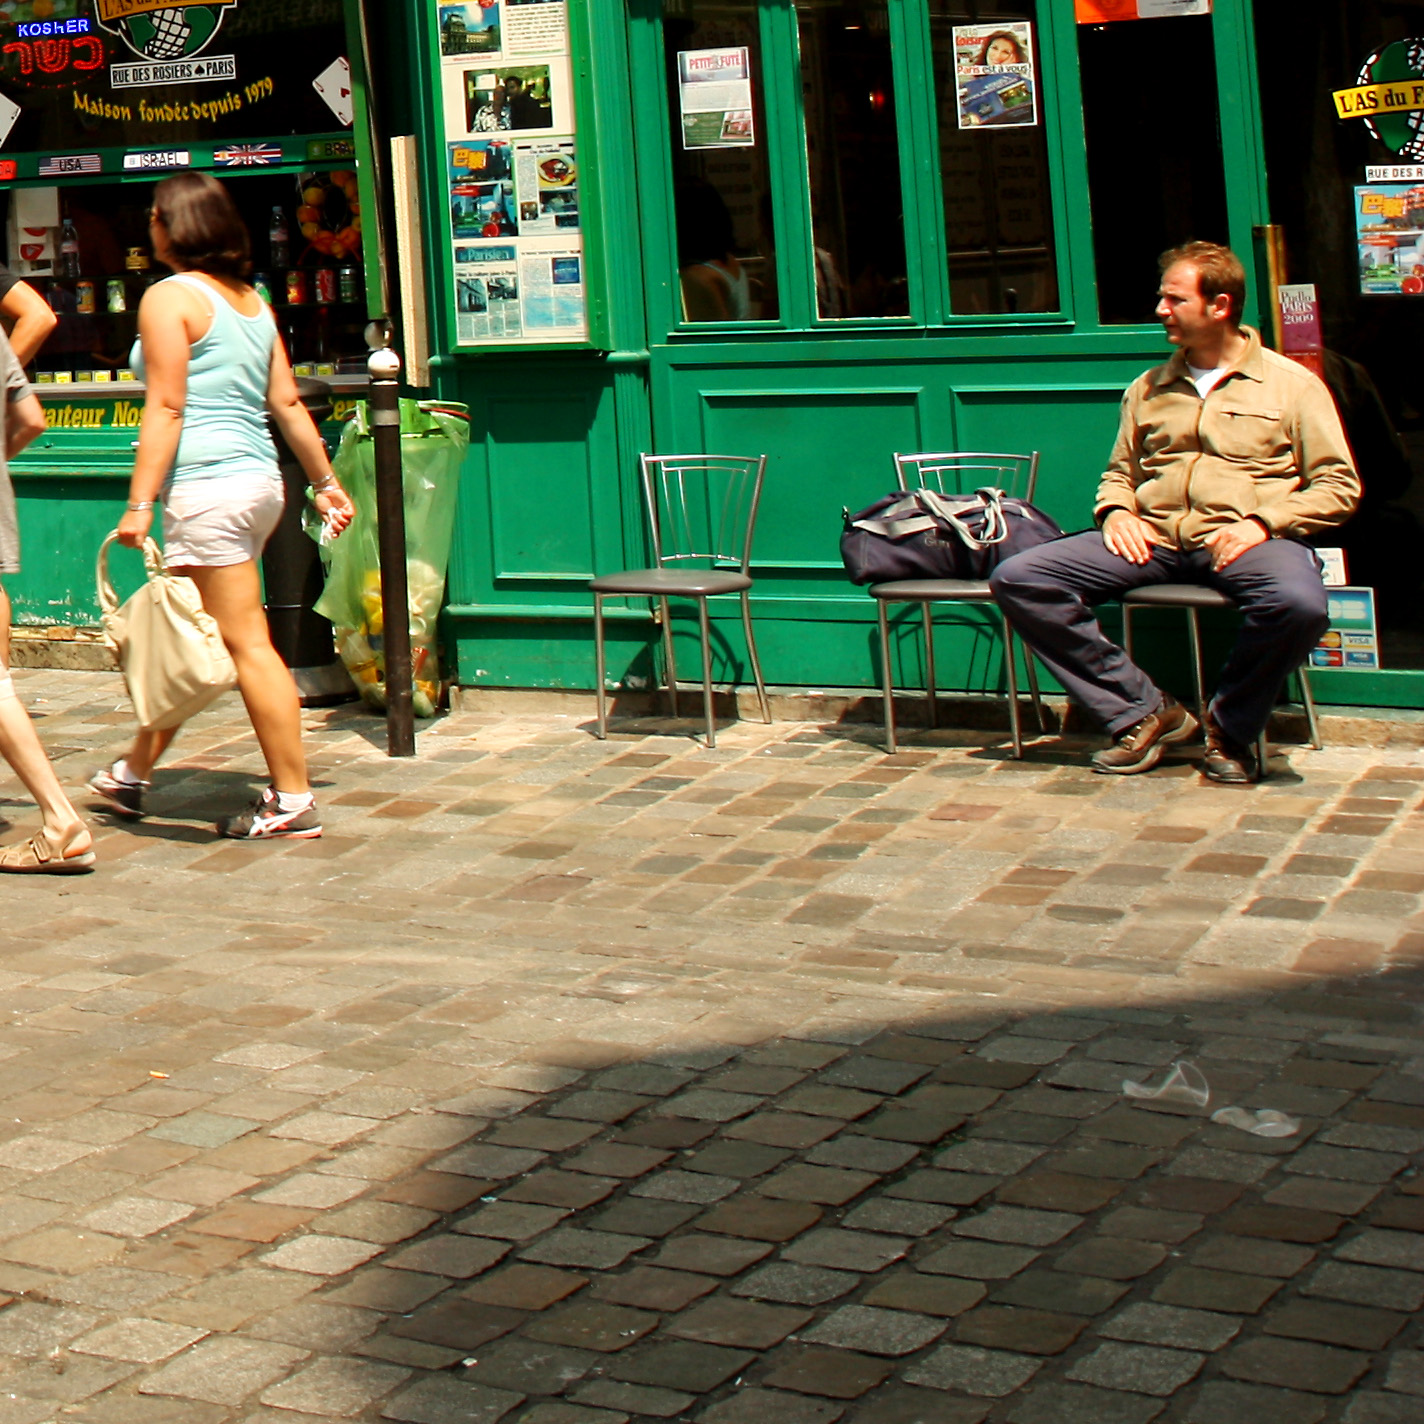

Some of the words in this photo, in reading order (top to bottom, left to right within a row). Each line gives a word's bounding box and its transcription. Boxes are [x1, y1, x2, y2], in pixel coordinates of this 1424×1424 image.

[2, 35, 105, 74] כשר
[113, 70, 130, 83] RUE
[133, 68, 151, 81] DES
[153, 64, 192, 79] ROSIERS
[206, 60, 234, 75] PARIS
[74, 90, 132, 121] Maison
[139, 99, 190, 122] fondée
[190, 92, 242, 122] depuis
[244, 76, 273, 104] 1979
[1339, 91, 1378, 113] L'AS
[1384, 88, 1406, 107] du
[59, 158, 82, 173] USA
[141, 150, 180, 168] ISRAEL
[1367, 168, 1389, 178] RUE
[1392, 168, 1413, 178] DES
[1281, 301, 1313, 313] PARIS
[1283, 313, 1314, 325] 2009
